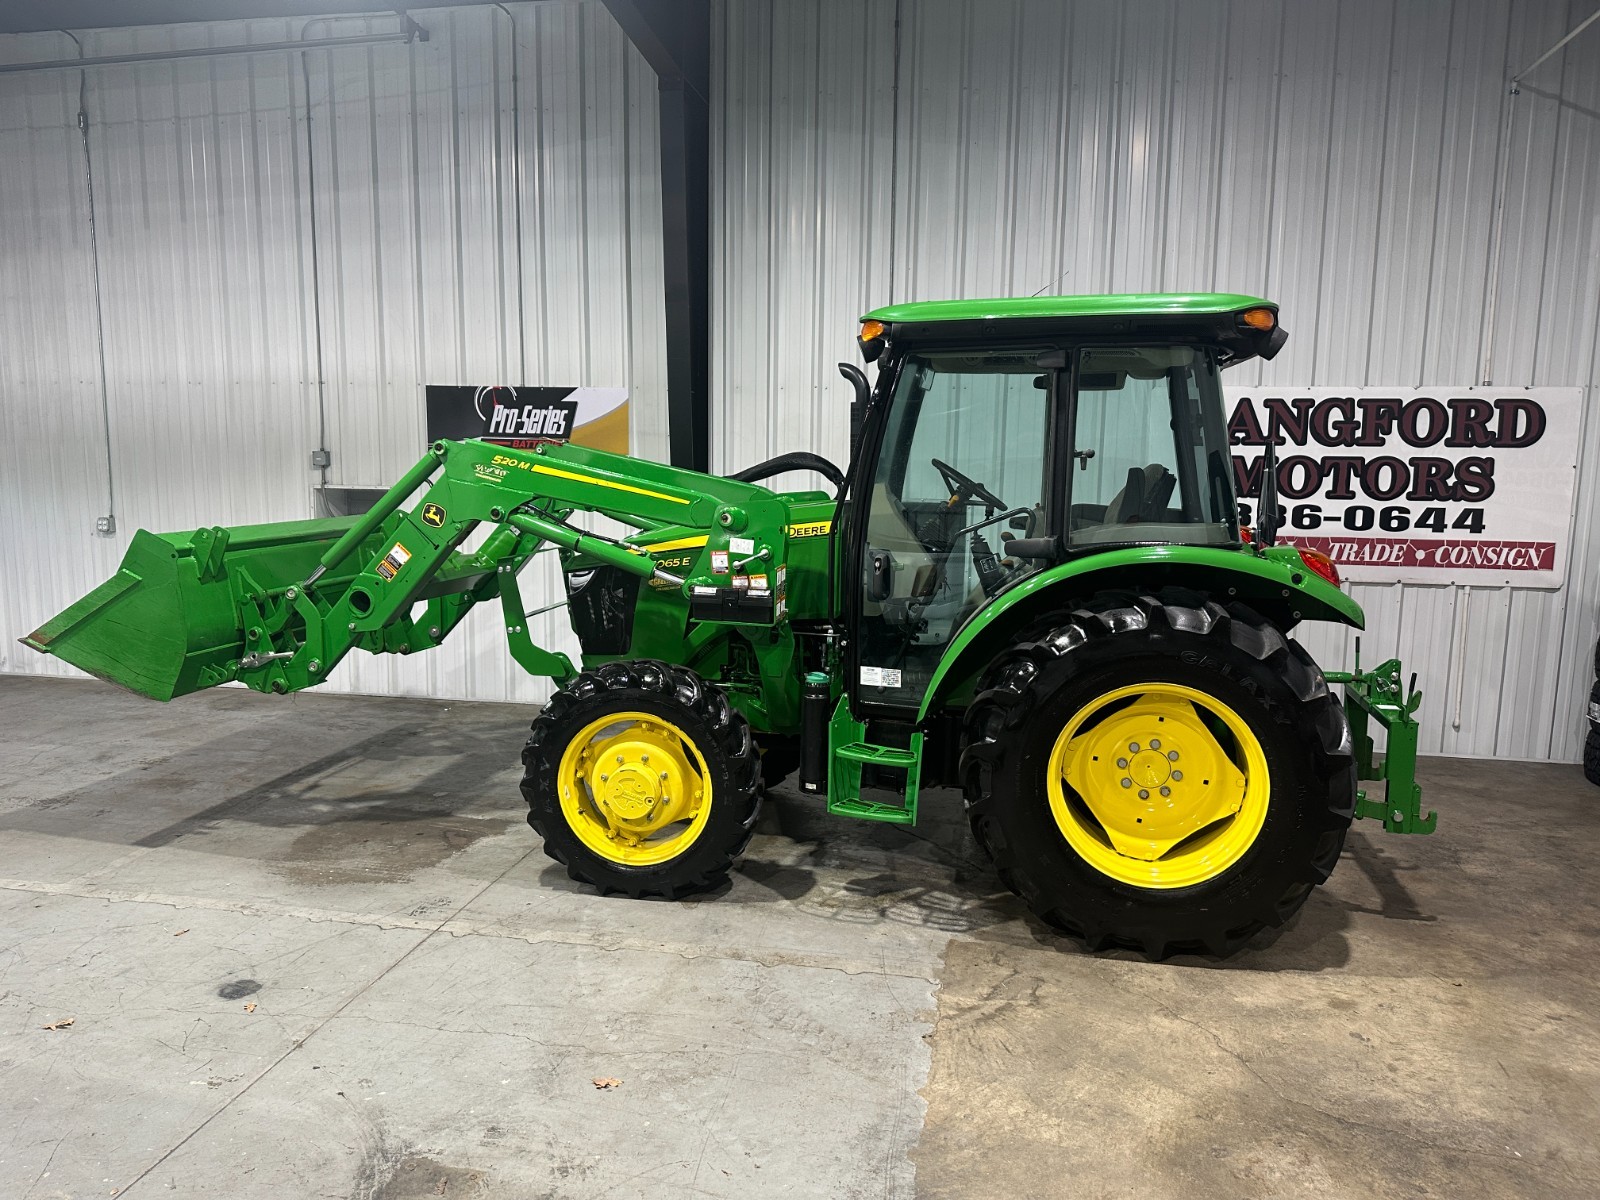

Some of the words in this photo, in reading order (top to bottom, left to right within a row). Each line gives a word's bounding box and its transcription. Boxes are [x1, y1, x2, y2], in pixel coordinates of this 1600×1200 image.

[489, 404, 569, 435] Pro-Series
[491, 455, 518, 467] 520
[517, 461, 531, 470] M
[1231, 454, 1496, 502] MOTORS
[789, 525, 827, 536] DEERE
[656, 557, 681, 568] 065
[682, 556, 691, 566] E
[1328, 542, 1407, 563] TRADE
[1434, 545, 1546, 567] CONSIGN
